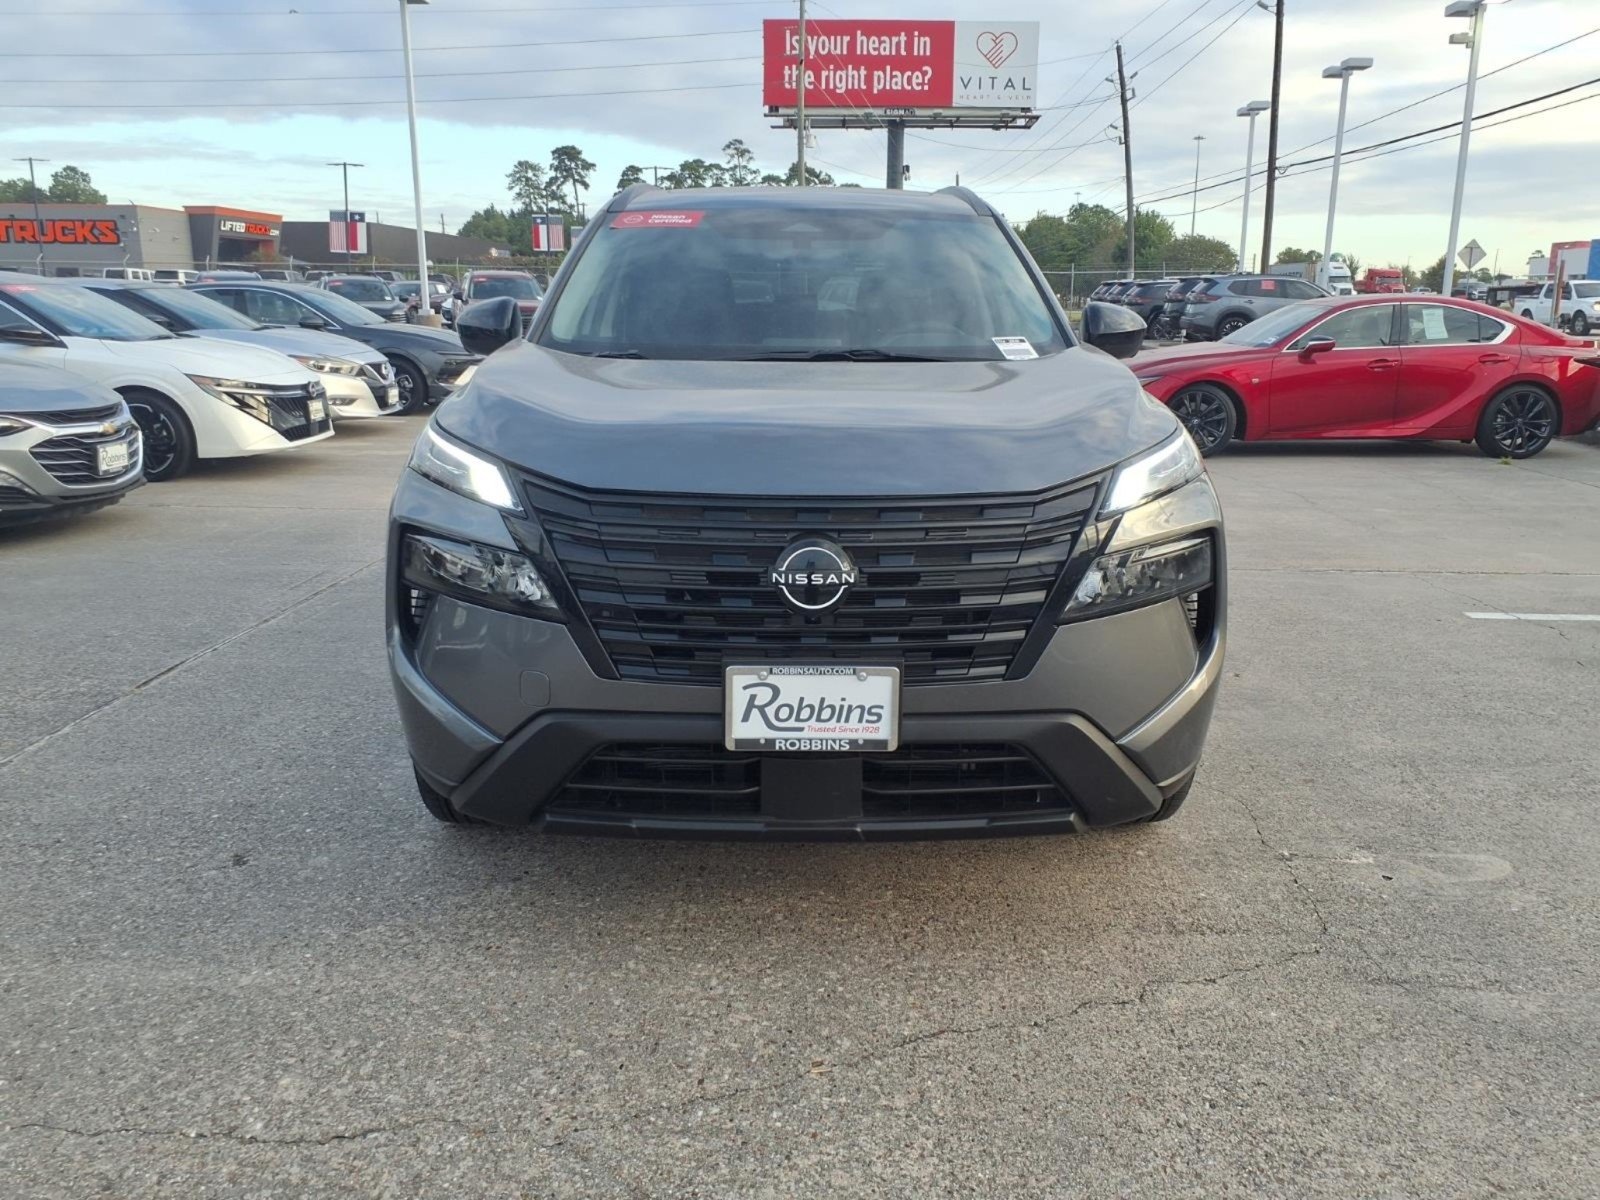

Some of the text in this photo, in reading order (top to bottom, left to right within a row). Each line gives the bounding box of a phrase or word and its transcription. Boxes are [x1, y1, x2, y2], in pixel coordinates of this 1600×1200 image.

[785, 30, 931, 59] Is your heart in
[784, 64, 933, 94] the right place?
[960, 76, 1032, 90] VITAL
[0, 219, 120, 244] TRUCKS
[772, 572, 855, 584] NISSAN
[772, 667, 854, 675] ROBBINSAUTO.COM
[741, 682, 885, 732] Robbins
[861, 726, 880, 734] 1928
[775, 739, 850, 751] ROBBINS
